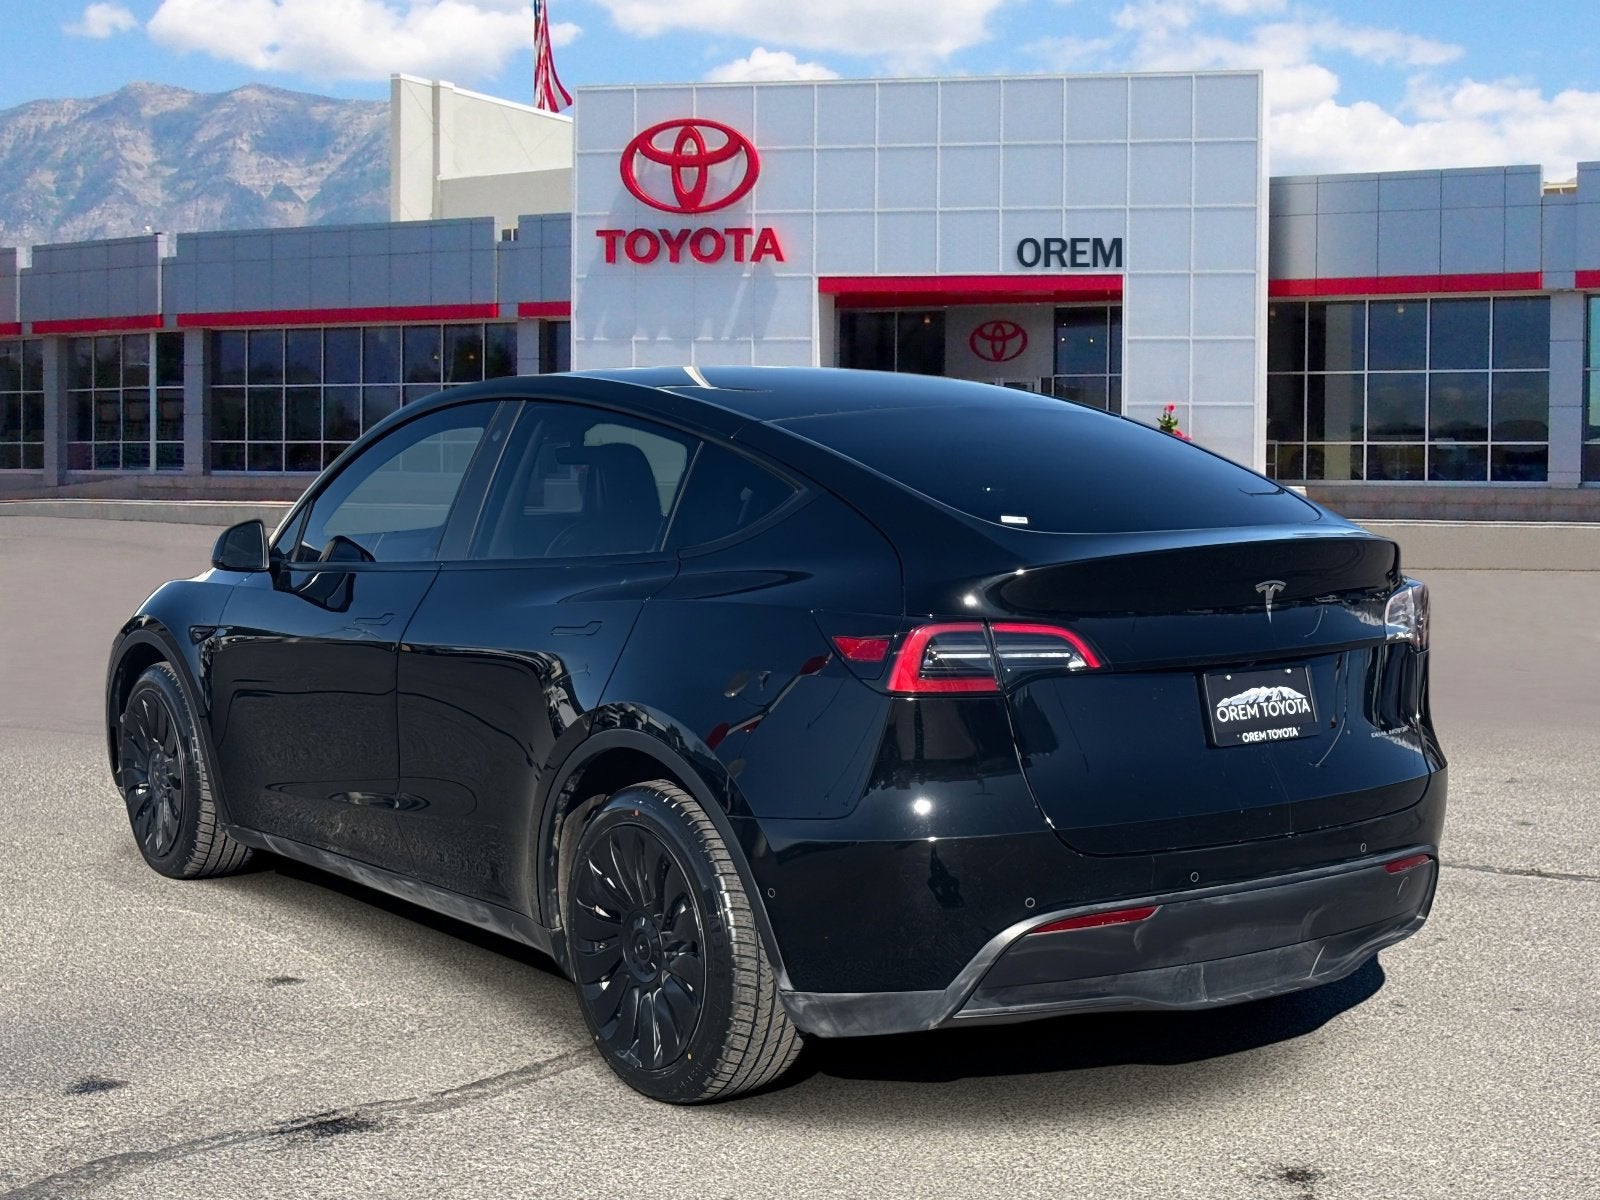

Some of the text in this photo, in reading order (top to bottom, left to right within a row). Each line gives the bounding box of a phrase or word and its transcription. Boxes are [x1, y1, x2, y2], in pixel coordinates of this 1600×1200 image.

[596, 228, 785, 264] TOYOTA
[1017, 237, 1123, 268] OREM
[1216, 699, 1311, 723] OREM TOYOTA
[1242, 727, 1299, 743] OREM TOYOTA
